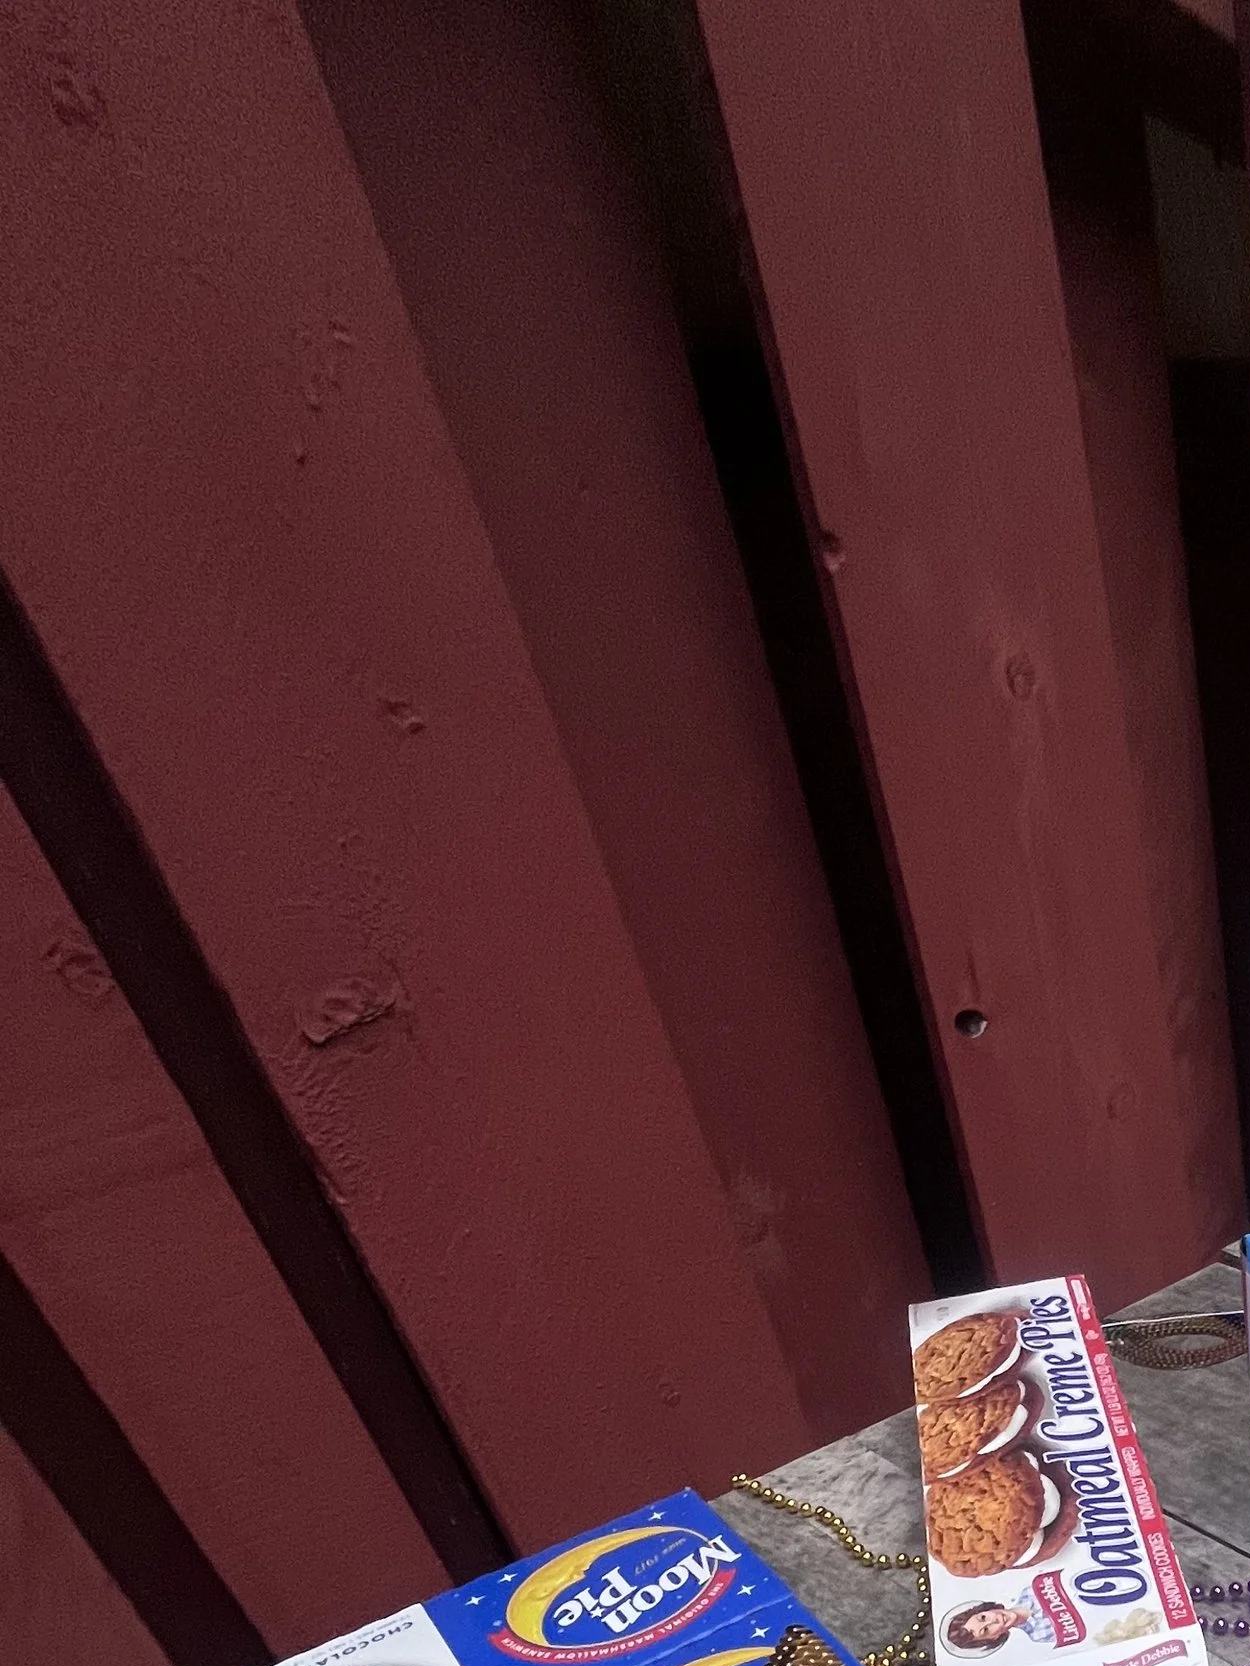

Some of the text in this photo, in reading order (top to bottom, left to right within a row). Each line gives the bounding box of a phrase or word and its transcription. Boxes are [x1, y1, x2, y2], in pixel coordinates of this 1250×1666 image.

[1020, 1296, 1077, 1350] Pies
[1040, 1352, 1105, 1441] Creme
[1046, 1446, 1148, 1606] Oatmeal
[1145, 1530, 1170, 1567] COOKIES
[553, 1566, 638, 1627] Pie
[601, 1534, 742, 1633] Moon
[1155, 1564, 1184, 1611] SANDWICH
[658, 1597, 710, 1635] ORIGINAL
[1040, 1576, 1079, 1643] Little Debbie
[1170, 1608, 1186, 1621] 12
[500, 1636, 551, 1660] SANDWICH
[554, 1633, 655, 1661] MARSHMALLOW
[1141, 1645, 1180, 1665] Debbie
